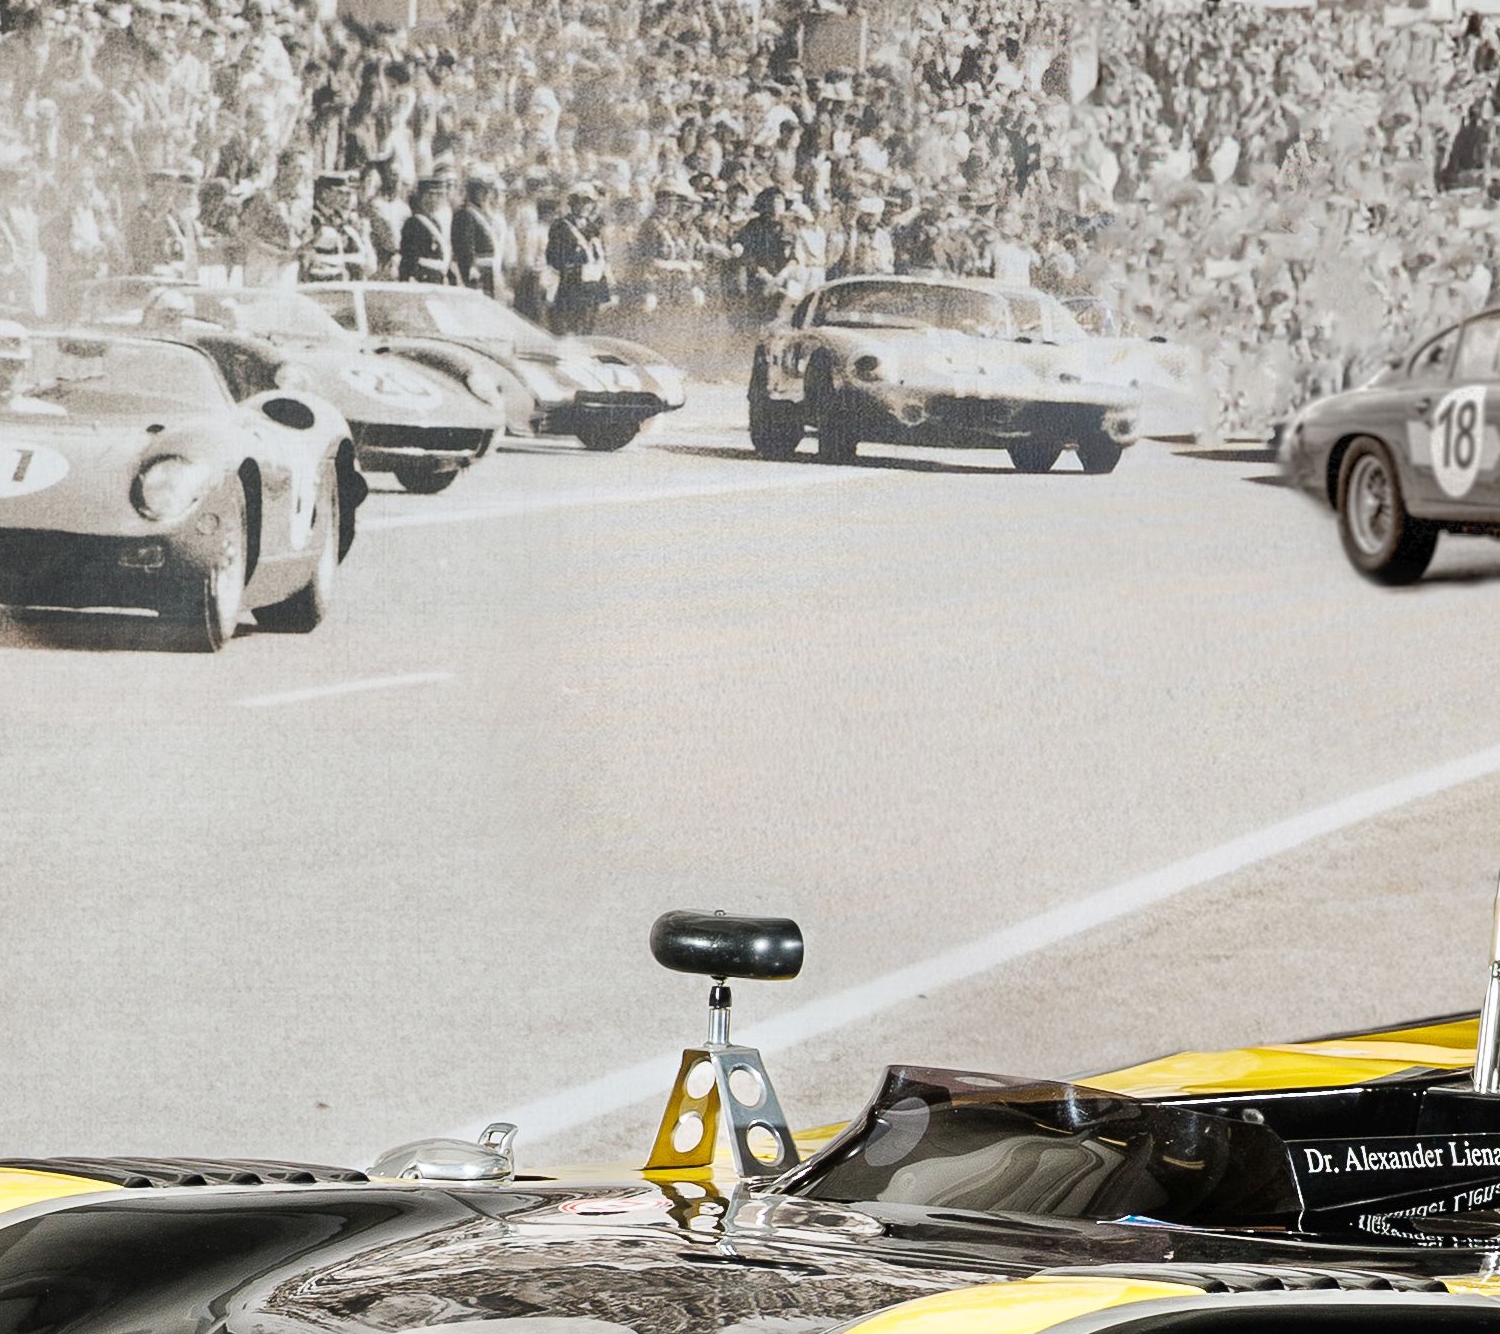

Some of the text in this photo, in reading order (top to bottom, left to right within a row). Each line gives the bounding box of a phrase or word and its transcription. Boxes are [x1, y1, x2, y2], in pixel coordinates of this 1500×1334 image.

[1438, 399, 1477, 470] 18
[1303, 1147, 1339, 1174] Dr.
[1345, 1142, 1444, 1172] Alexander
